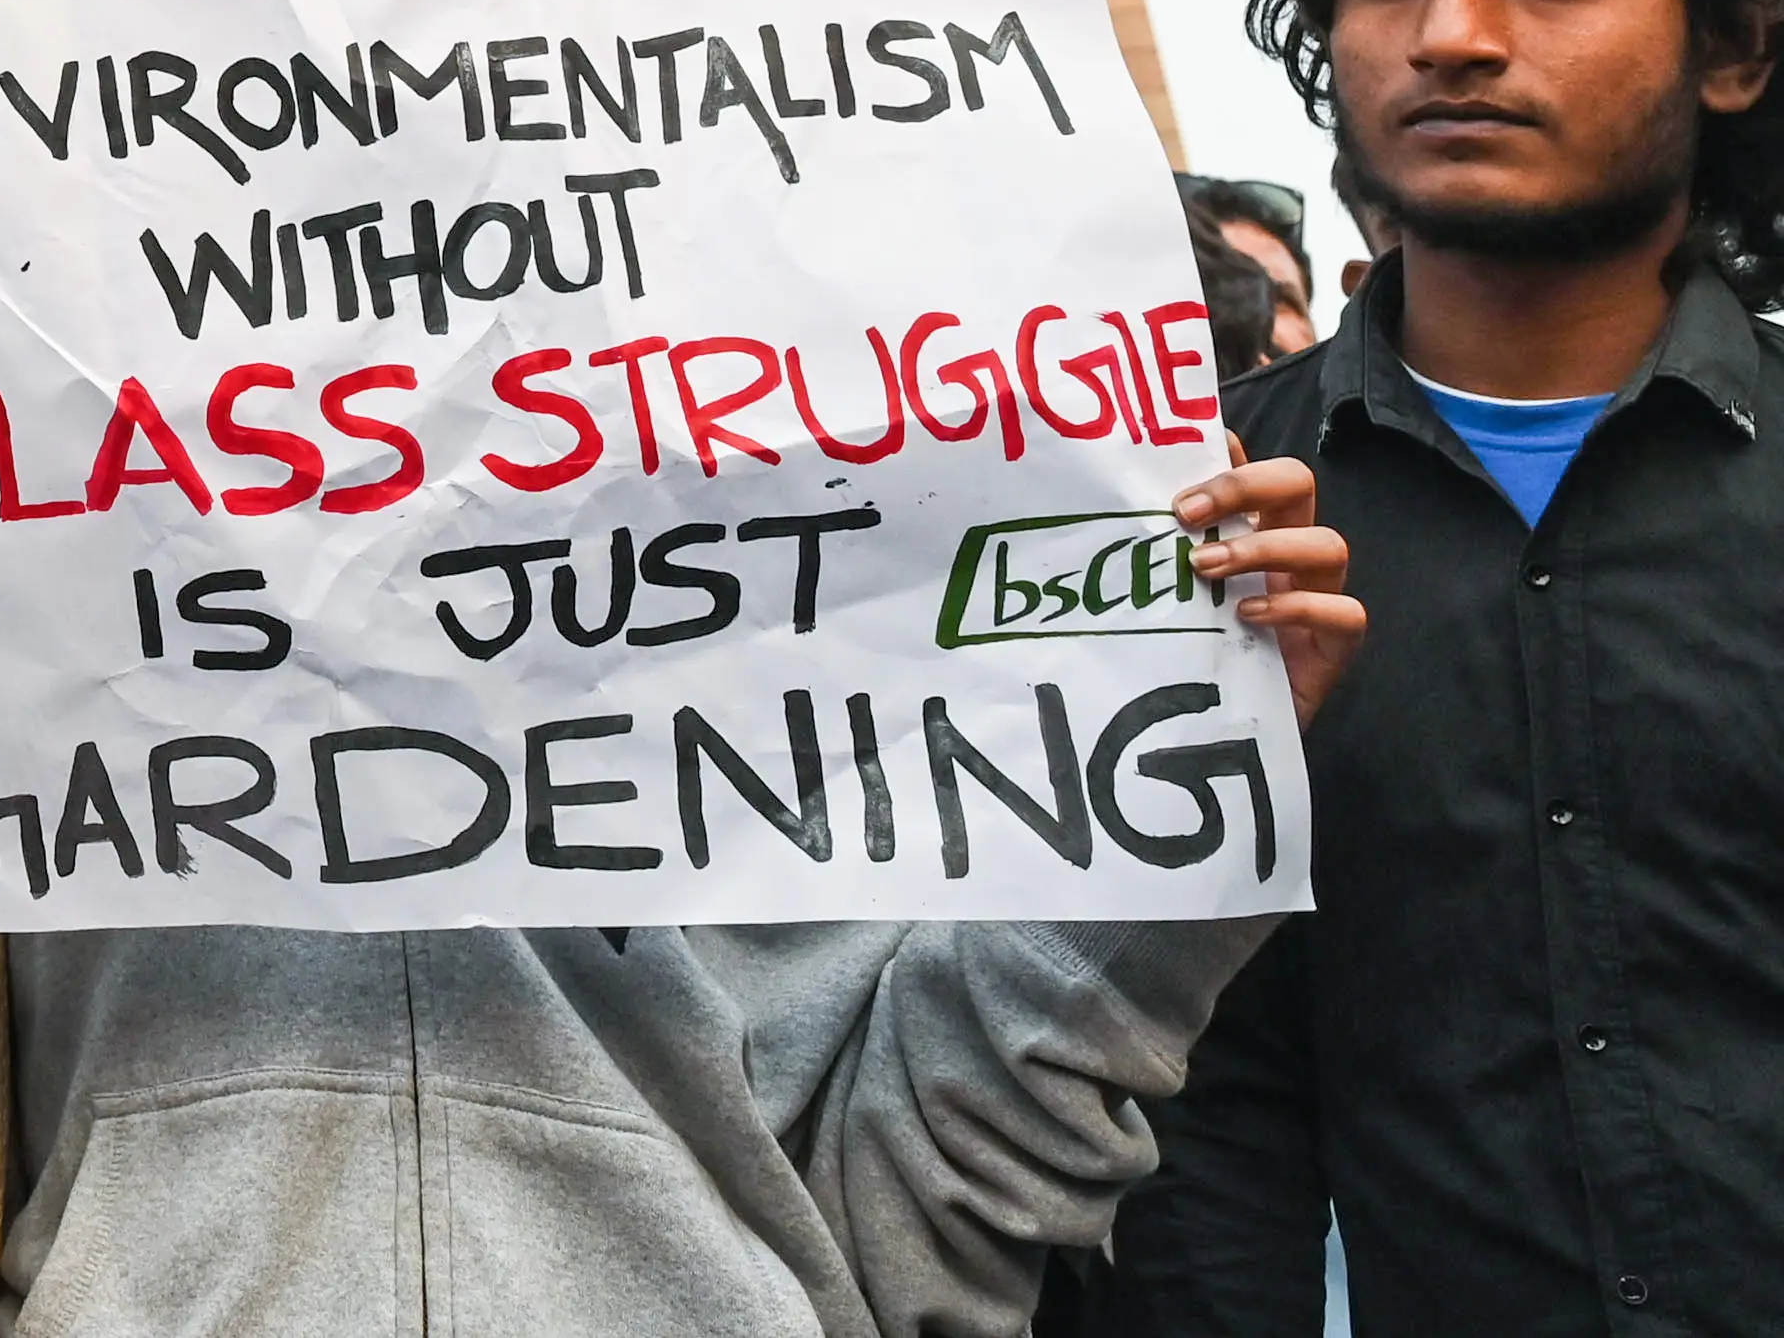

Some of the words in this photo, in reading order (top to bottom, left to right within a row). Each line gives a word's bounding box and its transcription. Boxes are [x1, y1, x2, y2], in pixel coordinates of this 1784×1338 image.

[140, 168, 660, 336] WITHOUT
[481, 301, 1218, 492] STRUGGLE
[133, 569, 292, 671] IS
[420, 505, 881, 665] JUST
